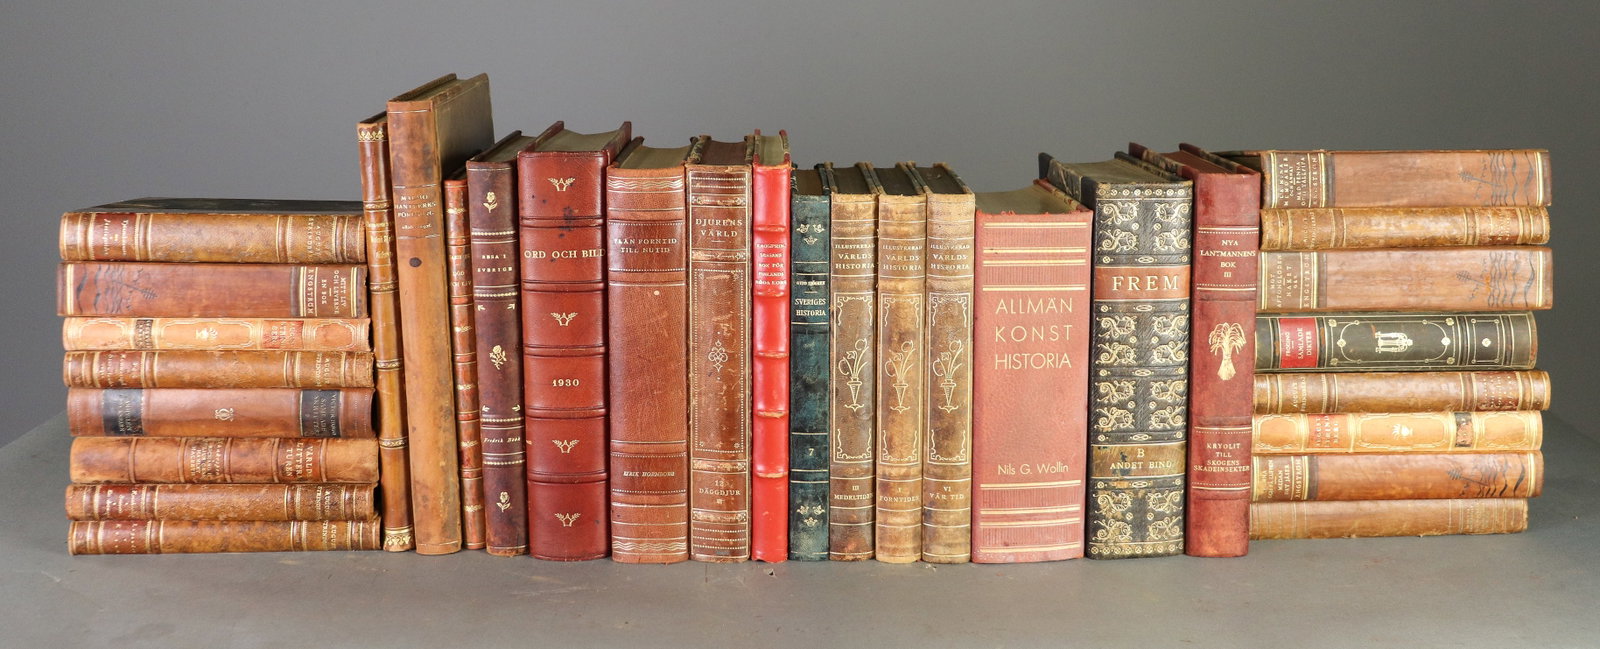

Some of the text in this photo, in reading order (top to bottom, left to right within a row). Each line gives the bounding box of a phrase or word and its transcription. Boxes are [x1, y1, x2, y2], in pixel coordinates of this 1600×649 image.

[701, 228, 738, 237] VÄRLD
[524, 248, 606, 259] ORD OCH BILD
[1112, 275, 1179, 291] FREM
[794, 298, 827, 306] SVERIGES
[995, 297, 1073, 315] ALLMÄN
[796, 309, 827, 317] HISTORIA
[995, 325, 1073, 343] KONST
[1296, 328, 1304, 360] SAMLADE
[1305, 332, 1313, 356] DIKTER
[994, 352, 1072, 370] HISTORIA
[552, 378, 580, 387] 1930
[1206, 442, 1241, 450] KRYOLIT
[808, 448, 814, 457] 7
[1136, 448, 1145, 458] B
[998, 461, 1069, 475] Nils G. Wollin
[1110, 460, 1172, 470] ANDET BIND
[1194, 465, 1250, 473] SKADEINSEKTER
[699, 487, 741, 496] DÄGGDJUR
[930, 492, 948, 500] VÅR
